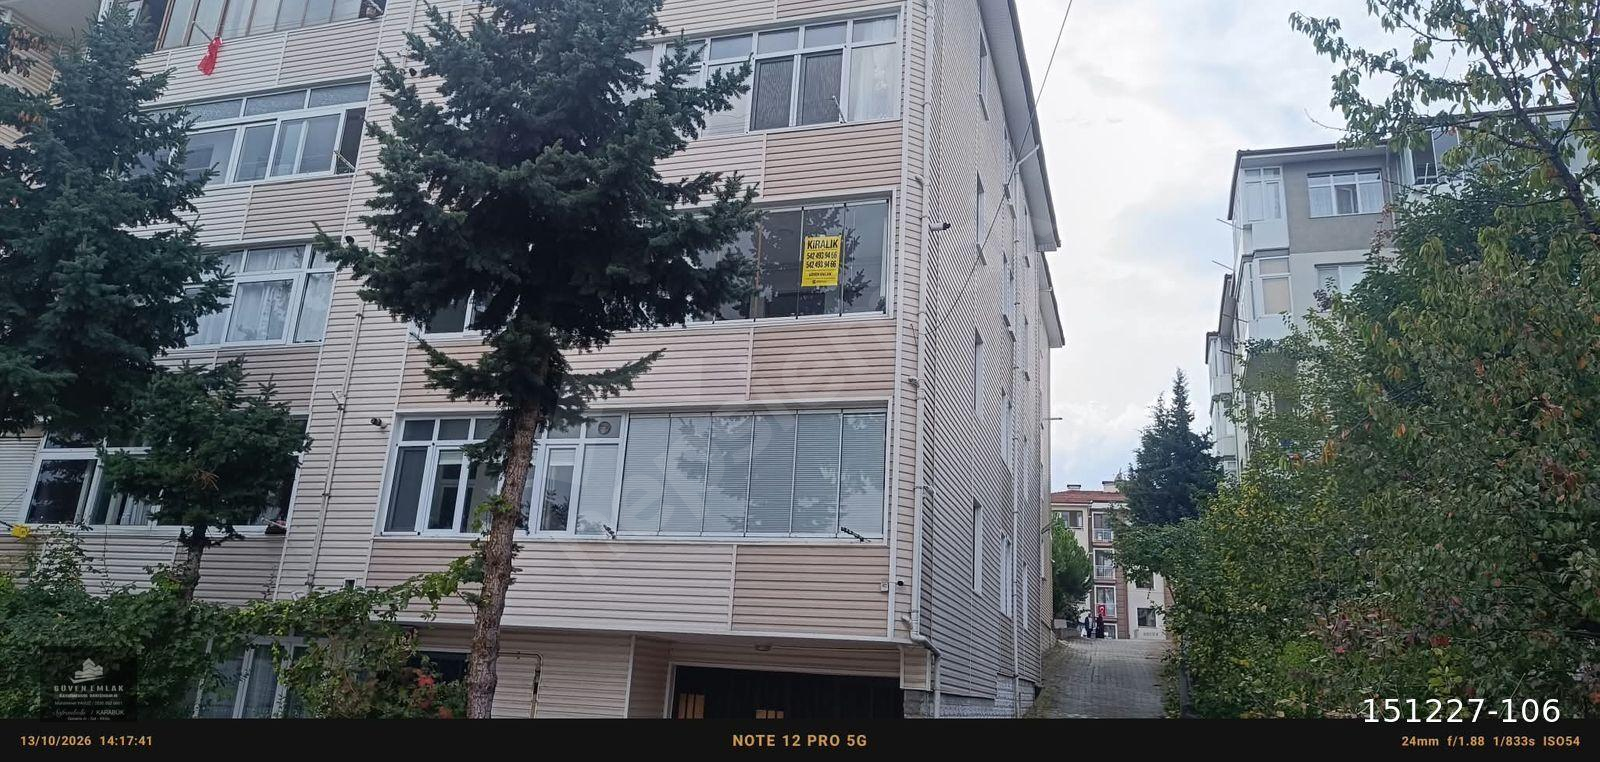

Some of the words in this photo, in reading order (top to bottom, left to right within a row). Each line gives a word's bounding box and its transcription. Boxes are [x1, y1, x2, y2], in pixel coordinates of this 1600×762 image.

[806, 252, 815, 260] 542
[815, 252, 824, 260] 493
[806, 261, 815, 269] 542
[815, 260, 824, 268] 493
[824, 260, 830, 268] 94
